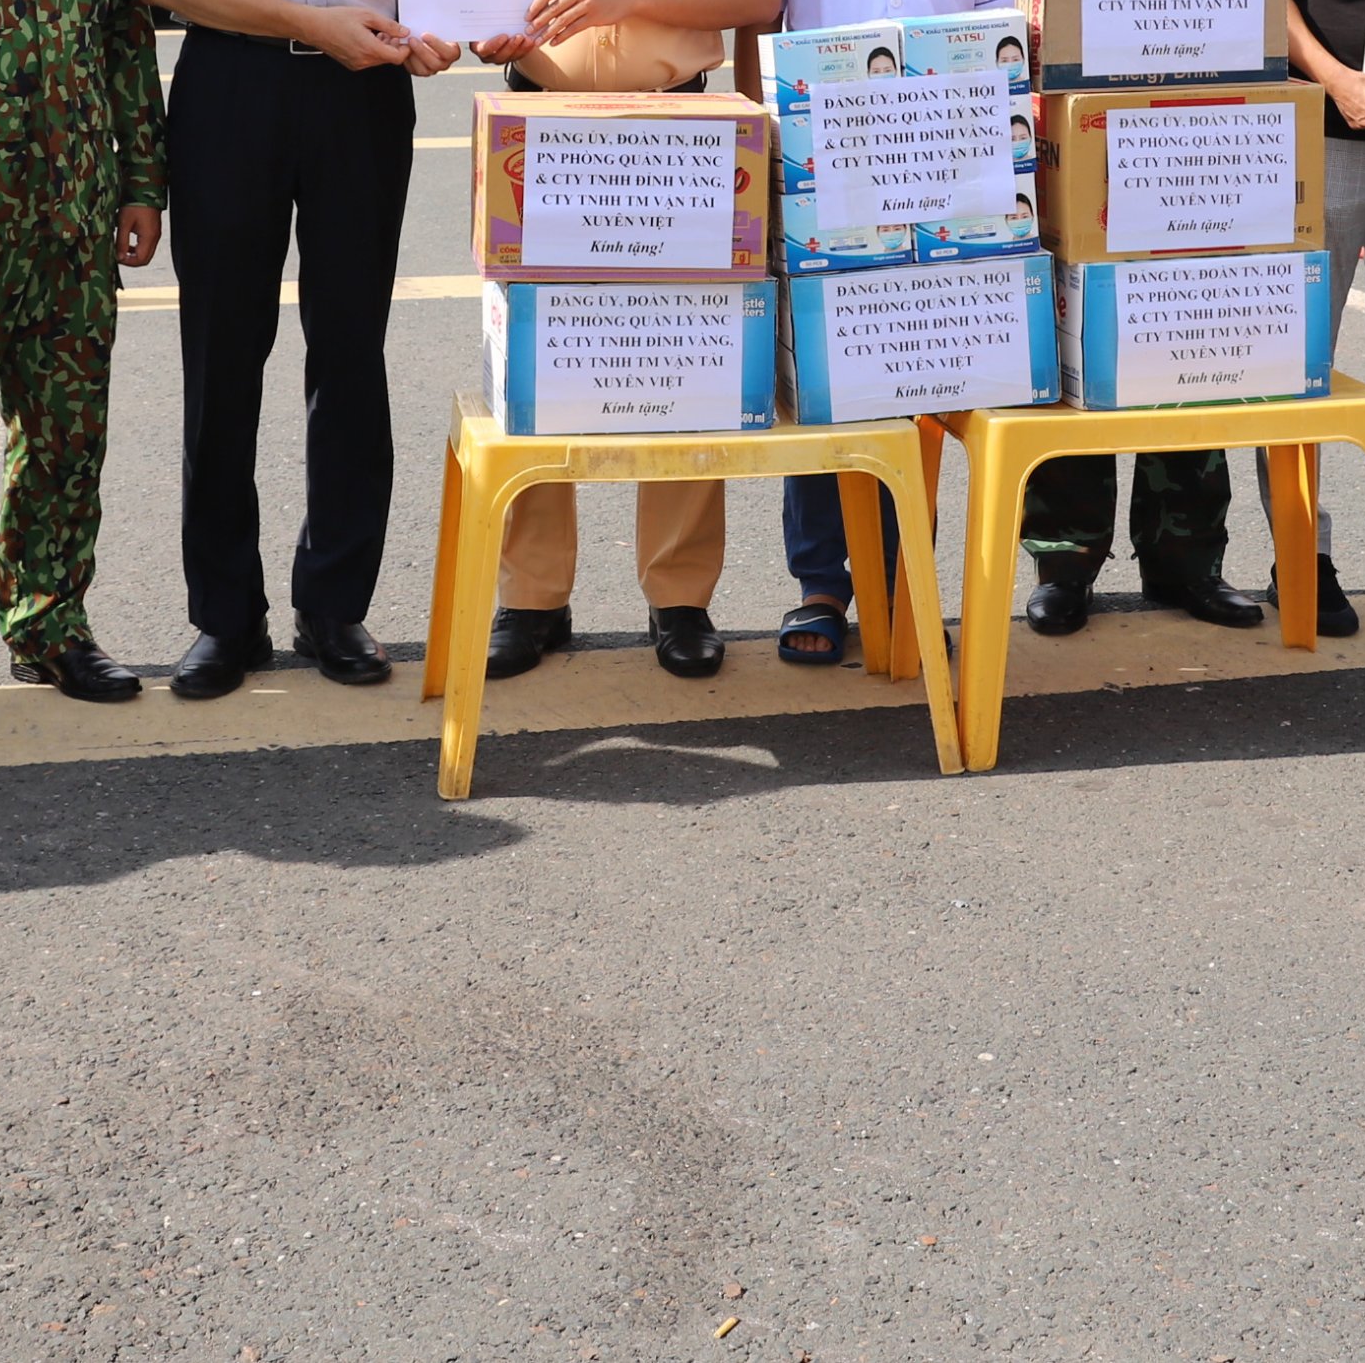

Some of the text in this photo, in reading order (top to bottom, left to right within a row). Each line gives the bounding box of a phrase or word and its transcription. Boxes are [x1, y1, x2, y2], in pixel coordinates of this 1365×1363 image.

[1097, 0, 1125, 12] CTY
[1133, 15, 1215, 33] XUYÊN VIỆT
[946, 32, 986, 44] TATSU
[816, 42, 857, 55] TATSU
[1140, 41, 1207, 58] Kính tặng!
[539, 131, 584, 145] ĐẢNG
[587, 132, 613, 146] ỦY,
[616, 130, 660, 146] ĐOÀN
[666, 133, 689, 147] TN,
[692, 133, 721, 150] HỘI
[536, 149, 723, 168] PN PHÒNG QUẢN LÝ XNC
[1035, 137, 1060, 168] ERN
[534, 172, 725, 189] & CTY TNHH ĐỈNH VÀNG,
[541, 193, 715, 211] CTY TNHH TM VẬN TẢI
[581, 211, 675, 231] XUYÊN VIỆT
[589, 239, 665, 257] Kính tặng!
[836, 270, 1011, 298] ĐẢNG ỦY, ĐOÀN TN, HỘI
[745, 298, 765, 309] stlé
[745, 308, 765, 317] ters
[835, 290, 1014, 318] PN PHÒNG QUẢN LÝ XNC
[835, 310, 1019, 338] & CTY TNHH ĐỈNH VÀNG,
[843, 331, 1010, 357] CTY TNHH TM VẬN TẢI
[1169, 343, 1253, 361] XUYÊN VIỆT
[884, 354, 974, 374] XUYÊN VIỆT
[1176, 368, 1245, 386] Kính tặng!
[894, 379, 966, 399] Kính tặng!
